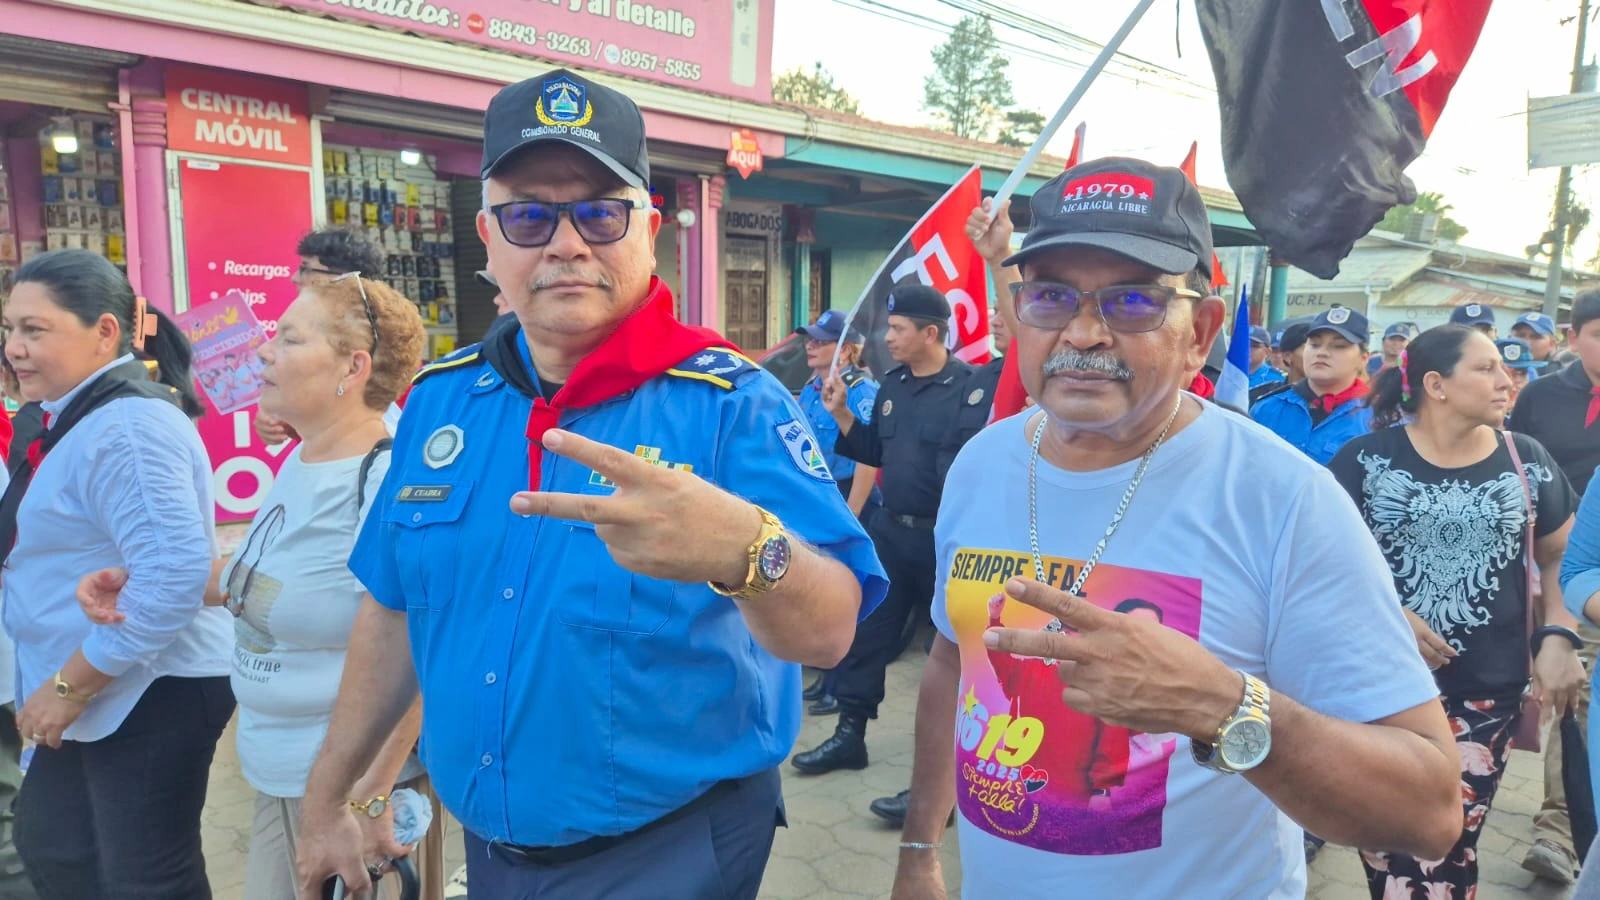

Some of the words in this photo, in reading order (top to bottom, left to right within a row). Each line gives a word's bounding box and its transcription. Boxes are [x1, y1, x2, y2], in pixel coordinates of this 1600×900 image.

[615, 0, 696, 37] detalle
[488, 18, 591, 57] 8843-3263
[181, 88, 297, 125] CENTRAL
[195, 118, 289, 152] MÓVIL
[570, 126, 601, 142] GENERAL
[1075, 183, 1136, 201] 1979
[1060, 199, 1113, 214] NICARAGUA
[1117, 202, 1149, 214] LIBRE
[726, 211, 781, 233] ABOGADOS
[224, 260, 290, 280] Recargas
[951, 552, 1029, 584] SIEMPRE
[251, 659, 281, 673] true
[976, 759, 1020, 782] 2025
